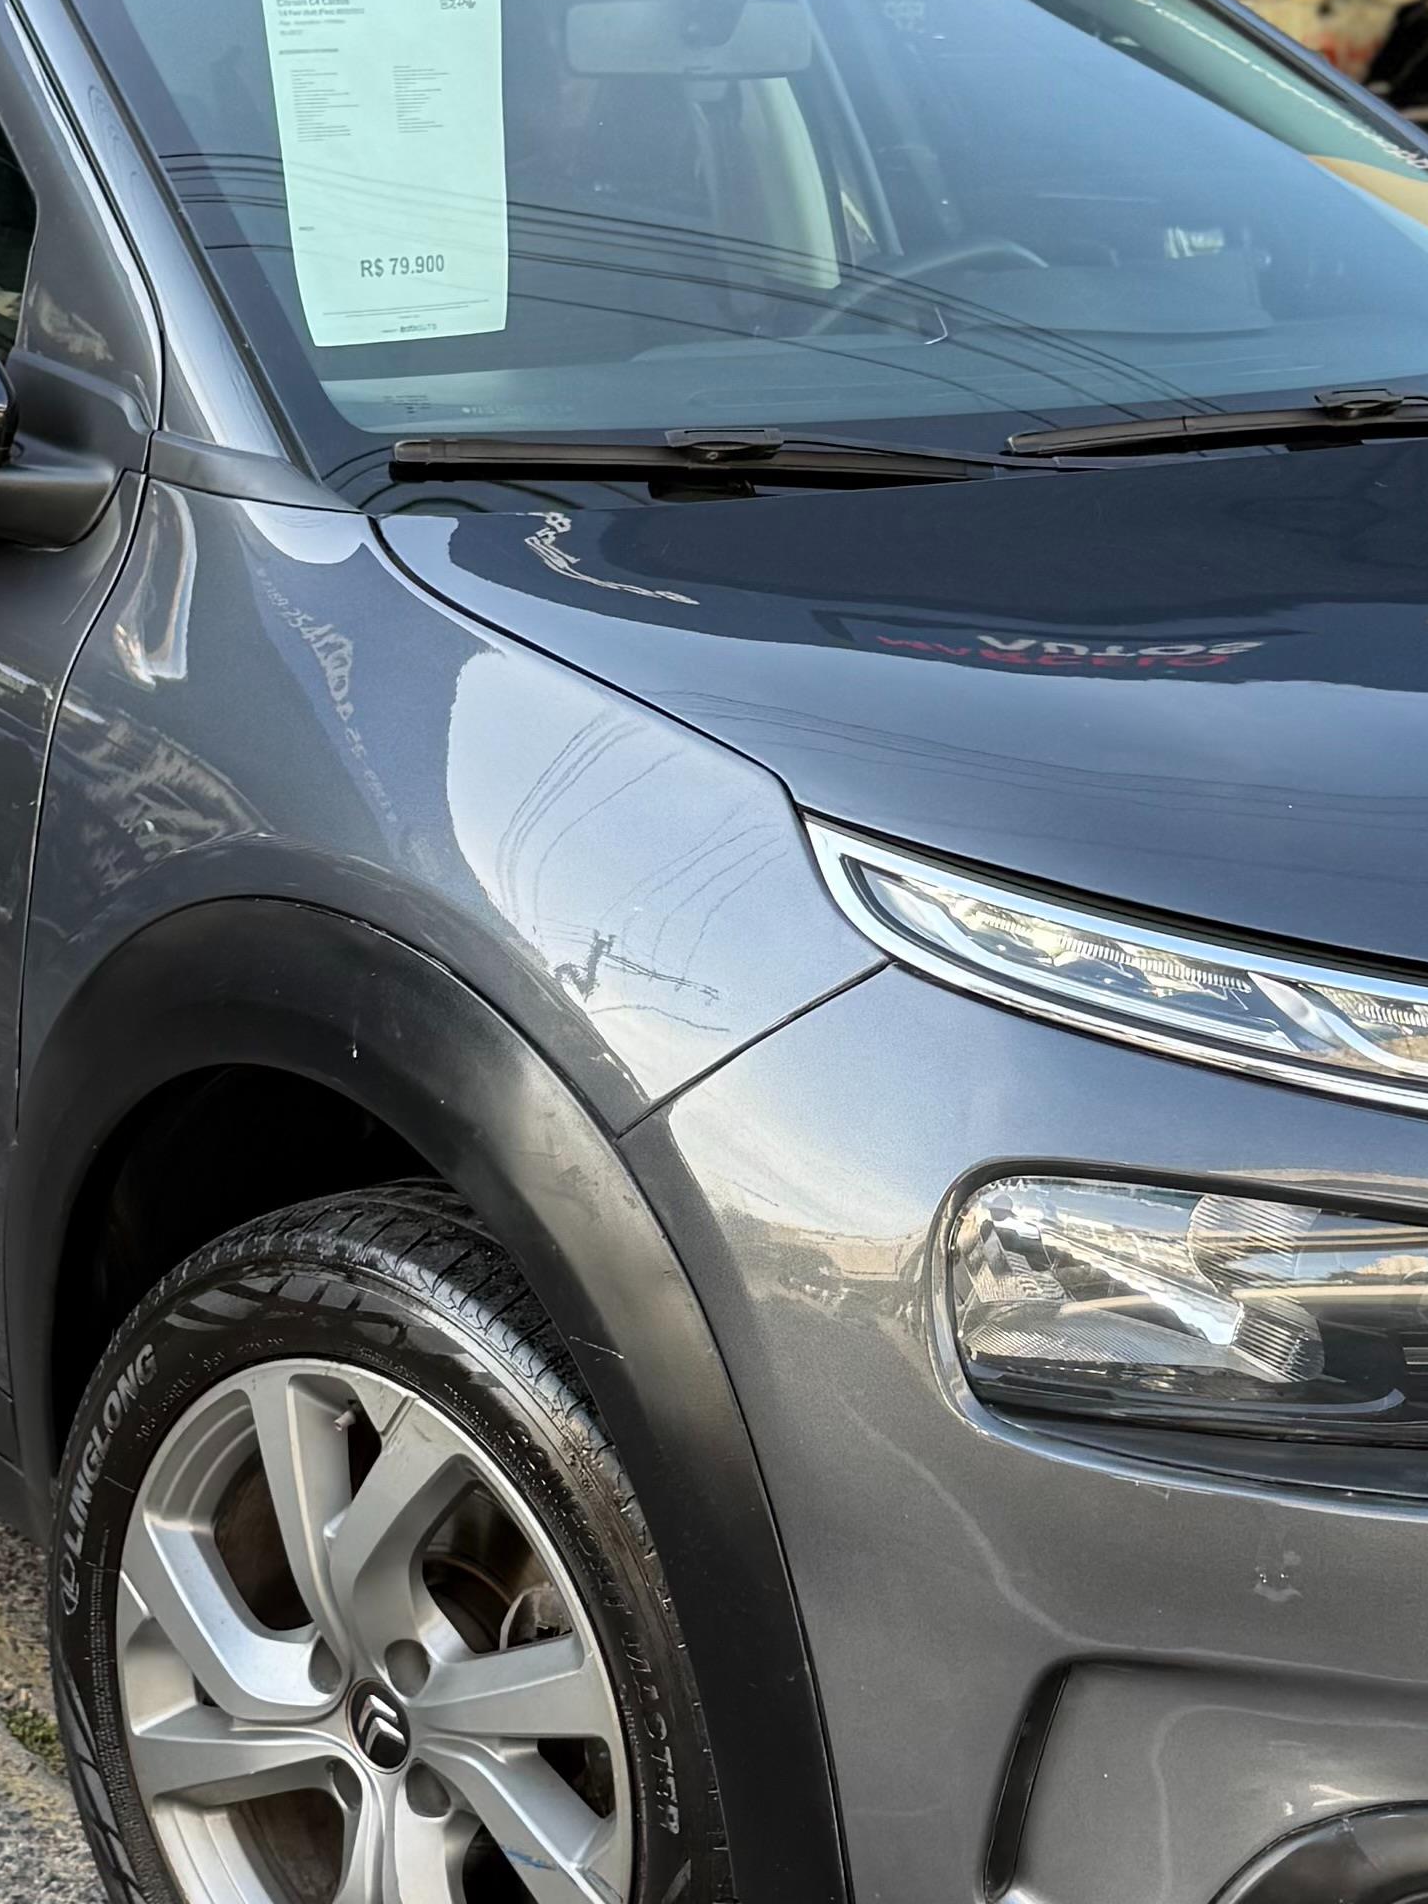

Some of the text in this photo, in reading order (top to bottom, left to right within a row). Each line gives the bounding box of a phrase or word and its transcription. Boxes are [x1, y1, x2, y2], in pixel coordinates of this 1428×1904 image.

[360, 254, 445, 278] R$ 79.900
[63, 1342, 160, 1562] LINGLONG
